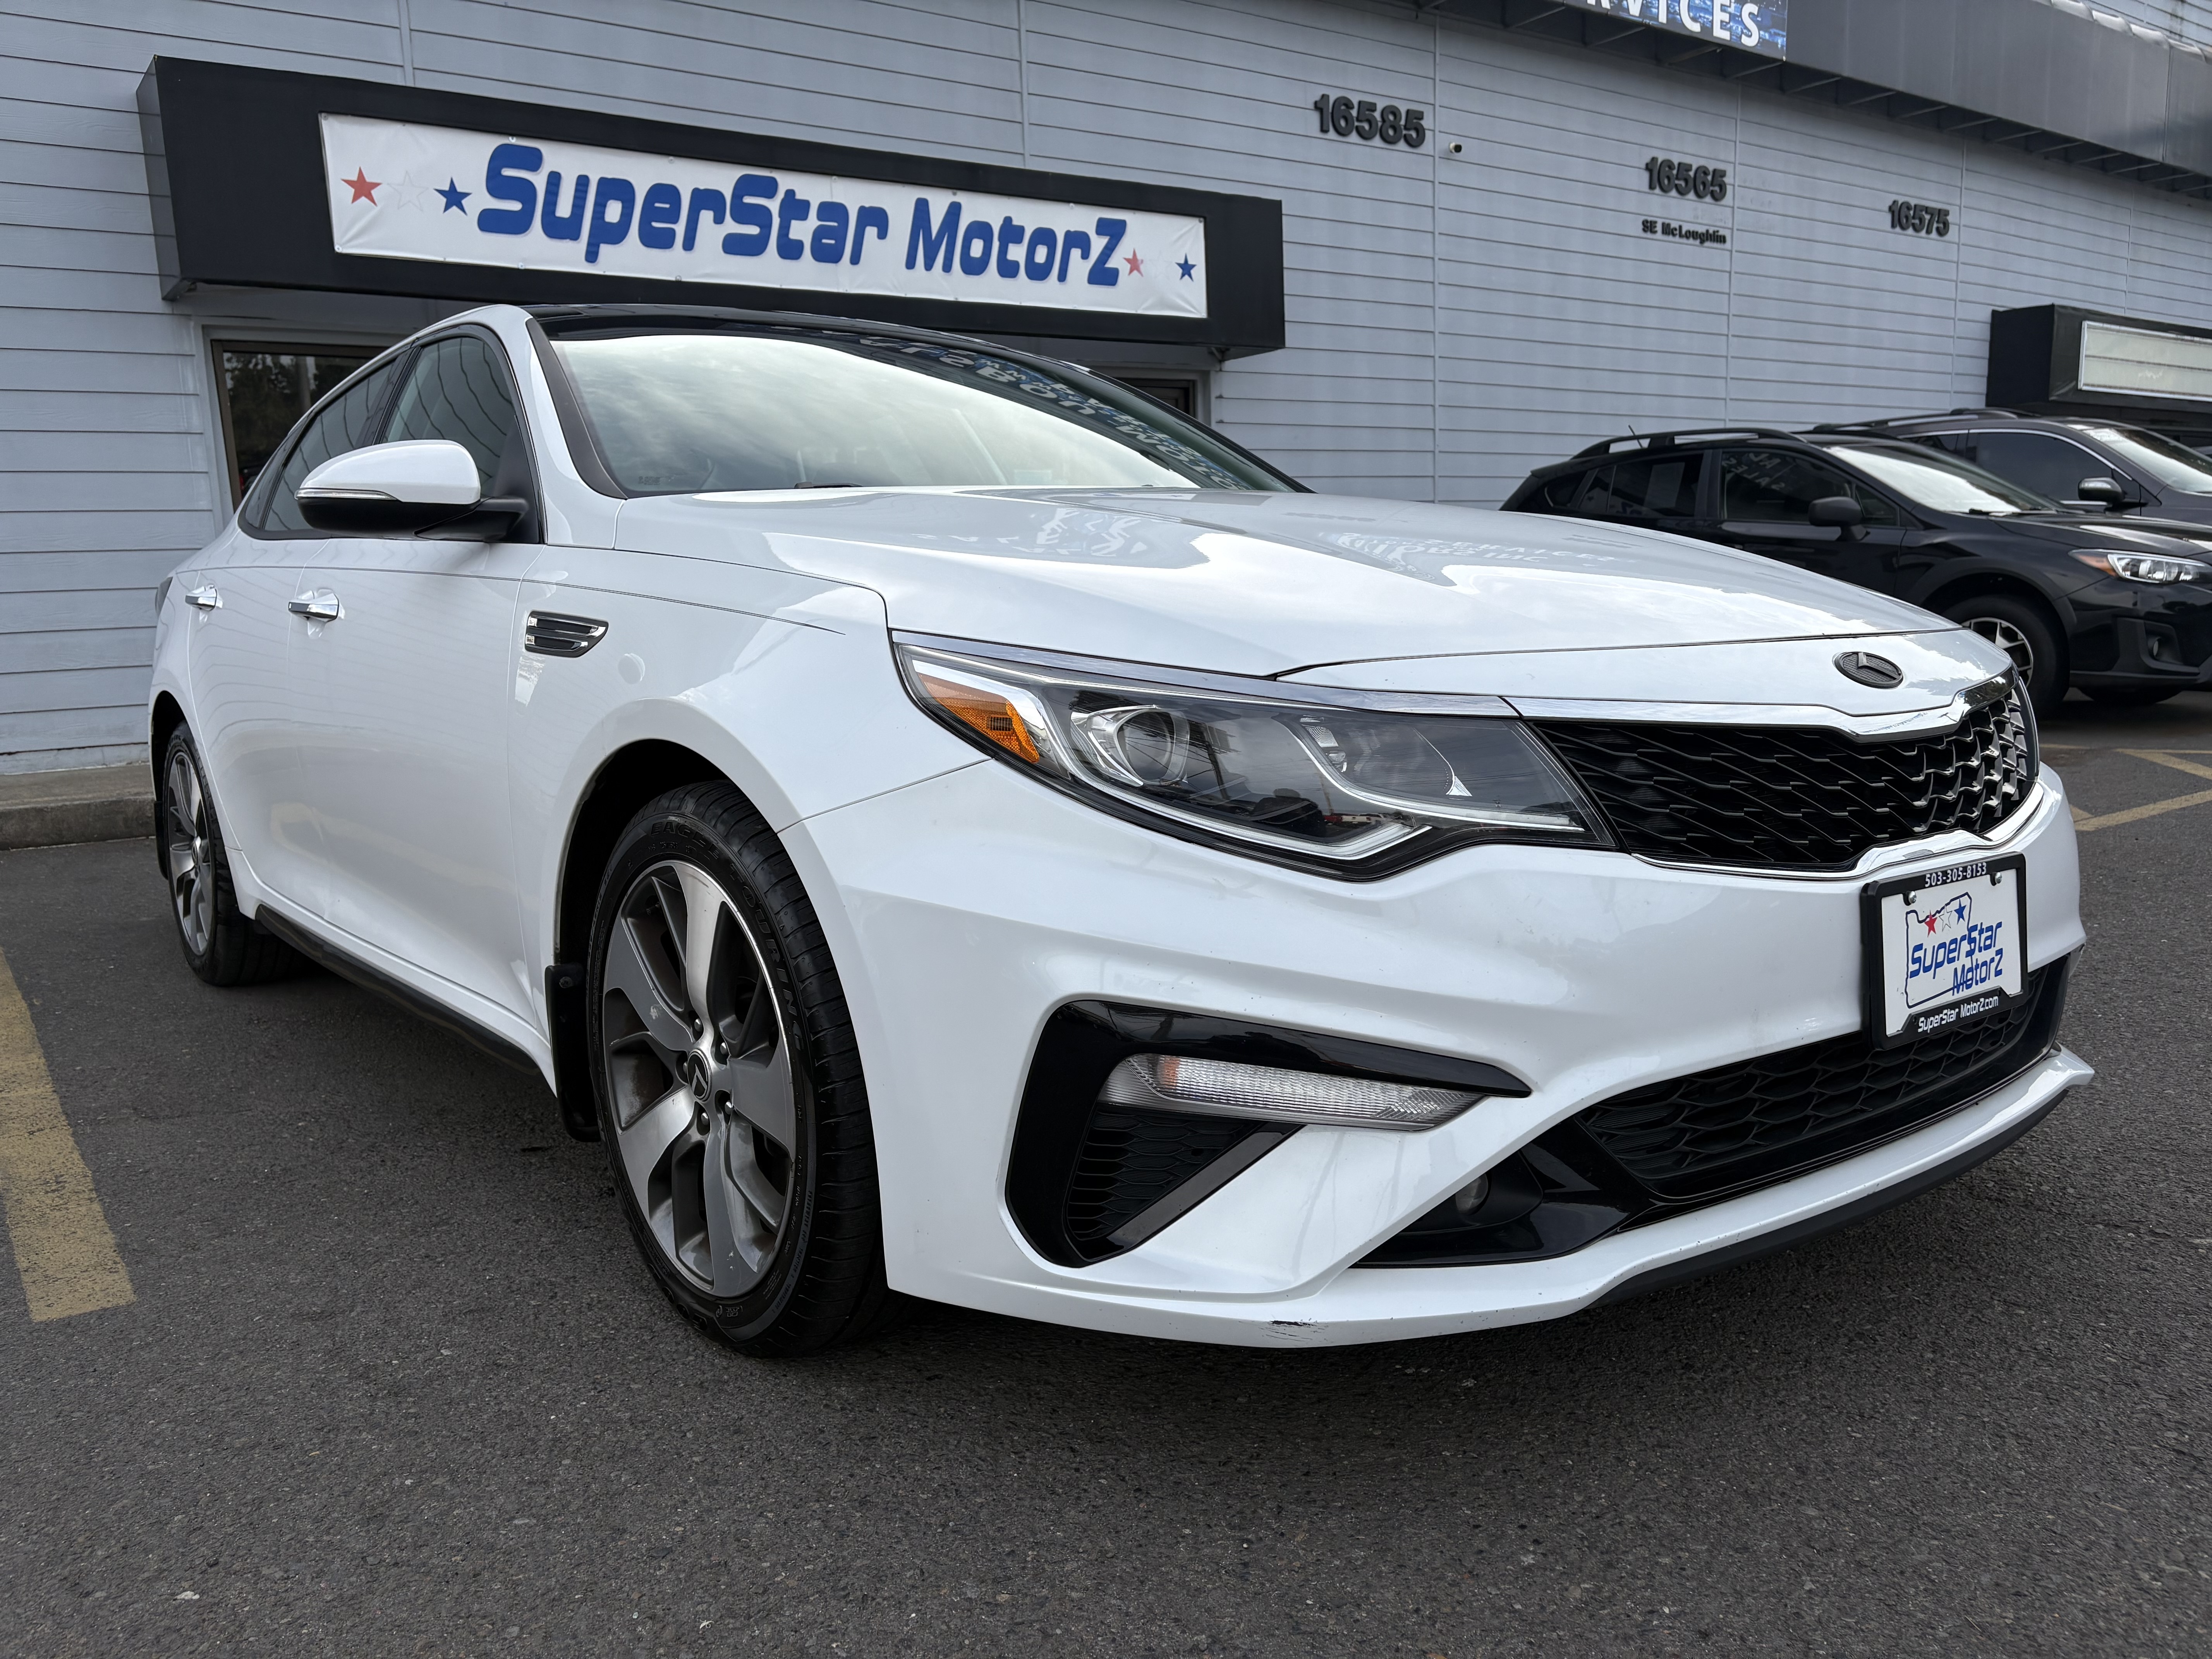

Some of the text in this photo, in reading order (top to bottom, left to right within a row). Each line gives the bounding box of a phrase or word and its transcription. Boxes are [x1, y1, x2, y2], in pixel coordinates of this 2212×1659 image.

[1314, 94, 1425, 148] 16585
[1645, 156, 1727, 202] 16565
[478, 144, 1127, 287] SuperStar MotorZ
[1642, 219, 1727, 245] SE McLoughlin
[1888, 200, 1949, 237] 16575
[651, 822, 720, 860] EAGLE
[1925, 862, 1987, 887] 503-305-8153
[1910, 922, 2002, 979] SuperStar
[1952, 948, 2003, 996] MotorZ
[1918, 996, 1999, 1033] SuperStar MotorZ.com
